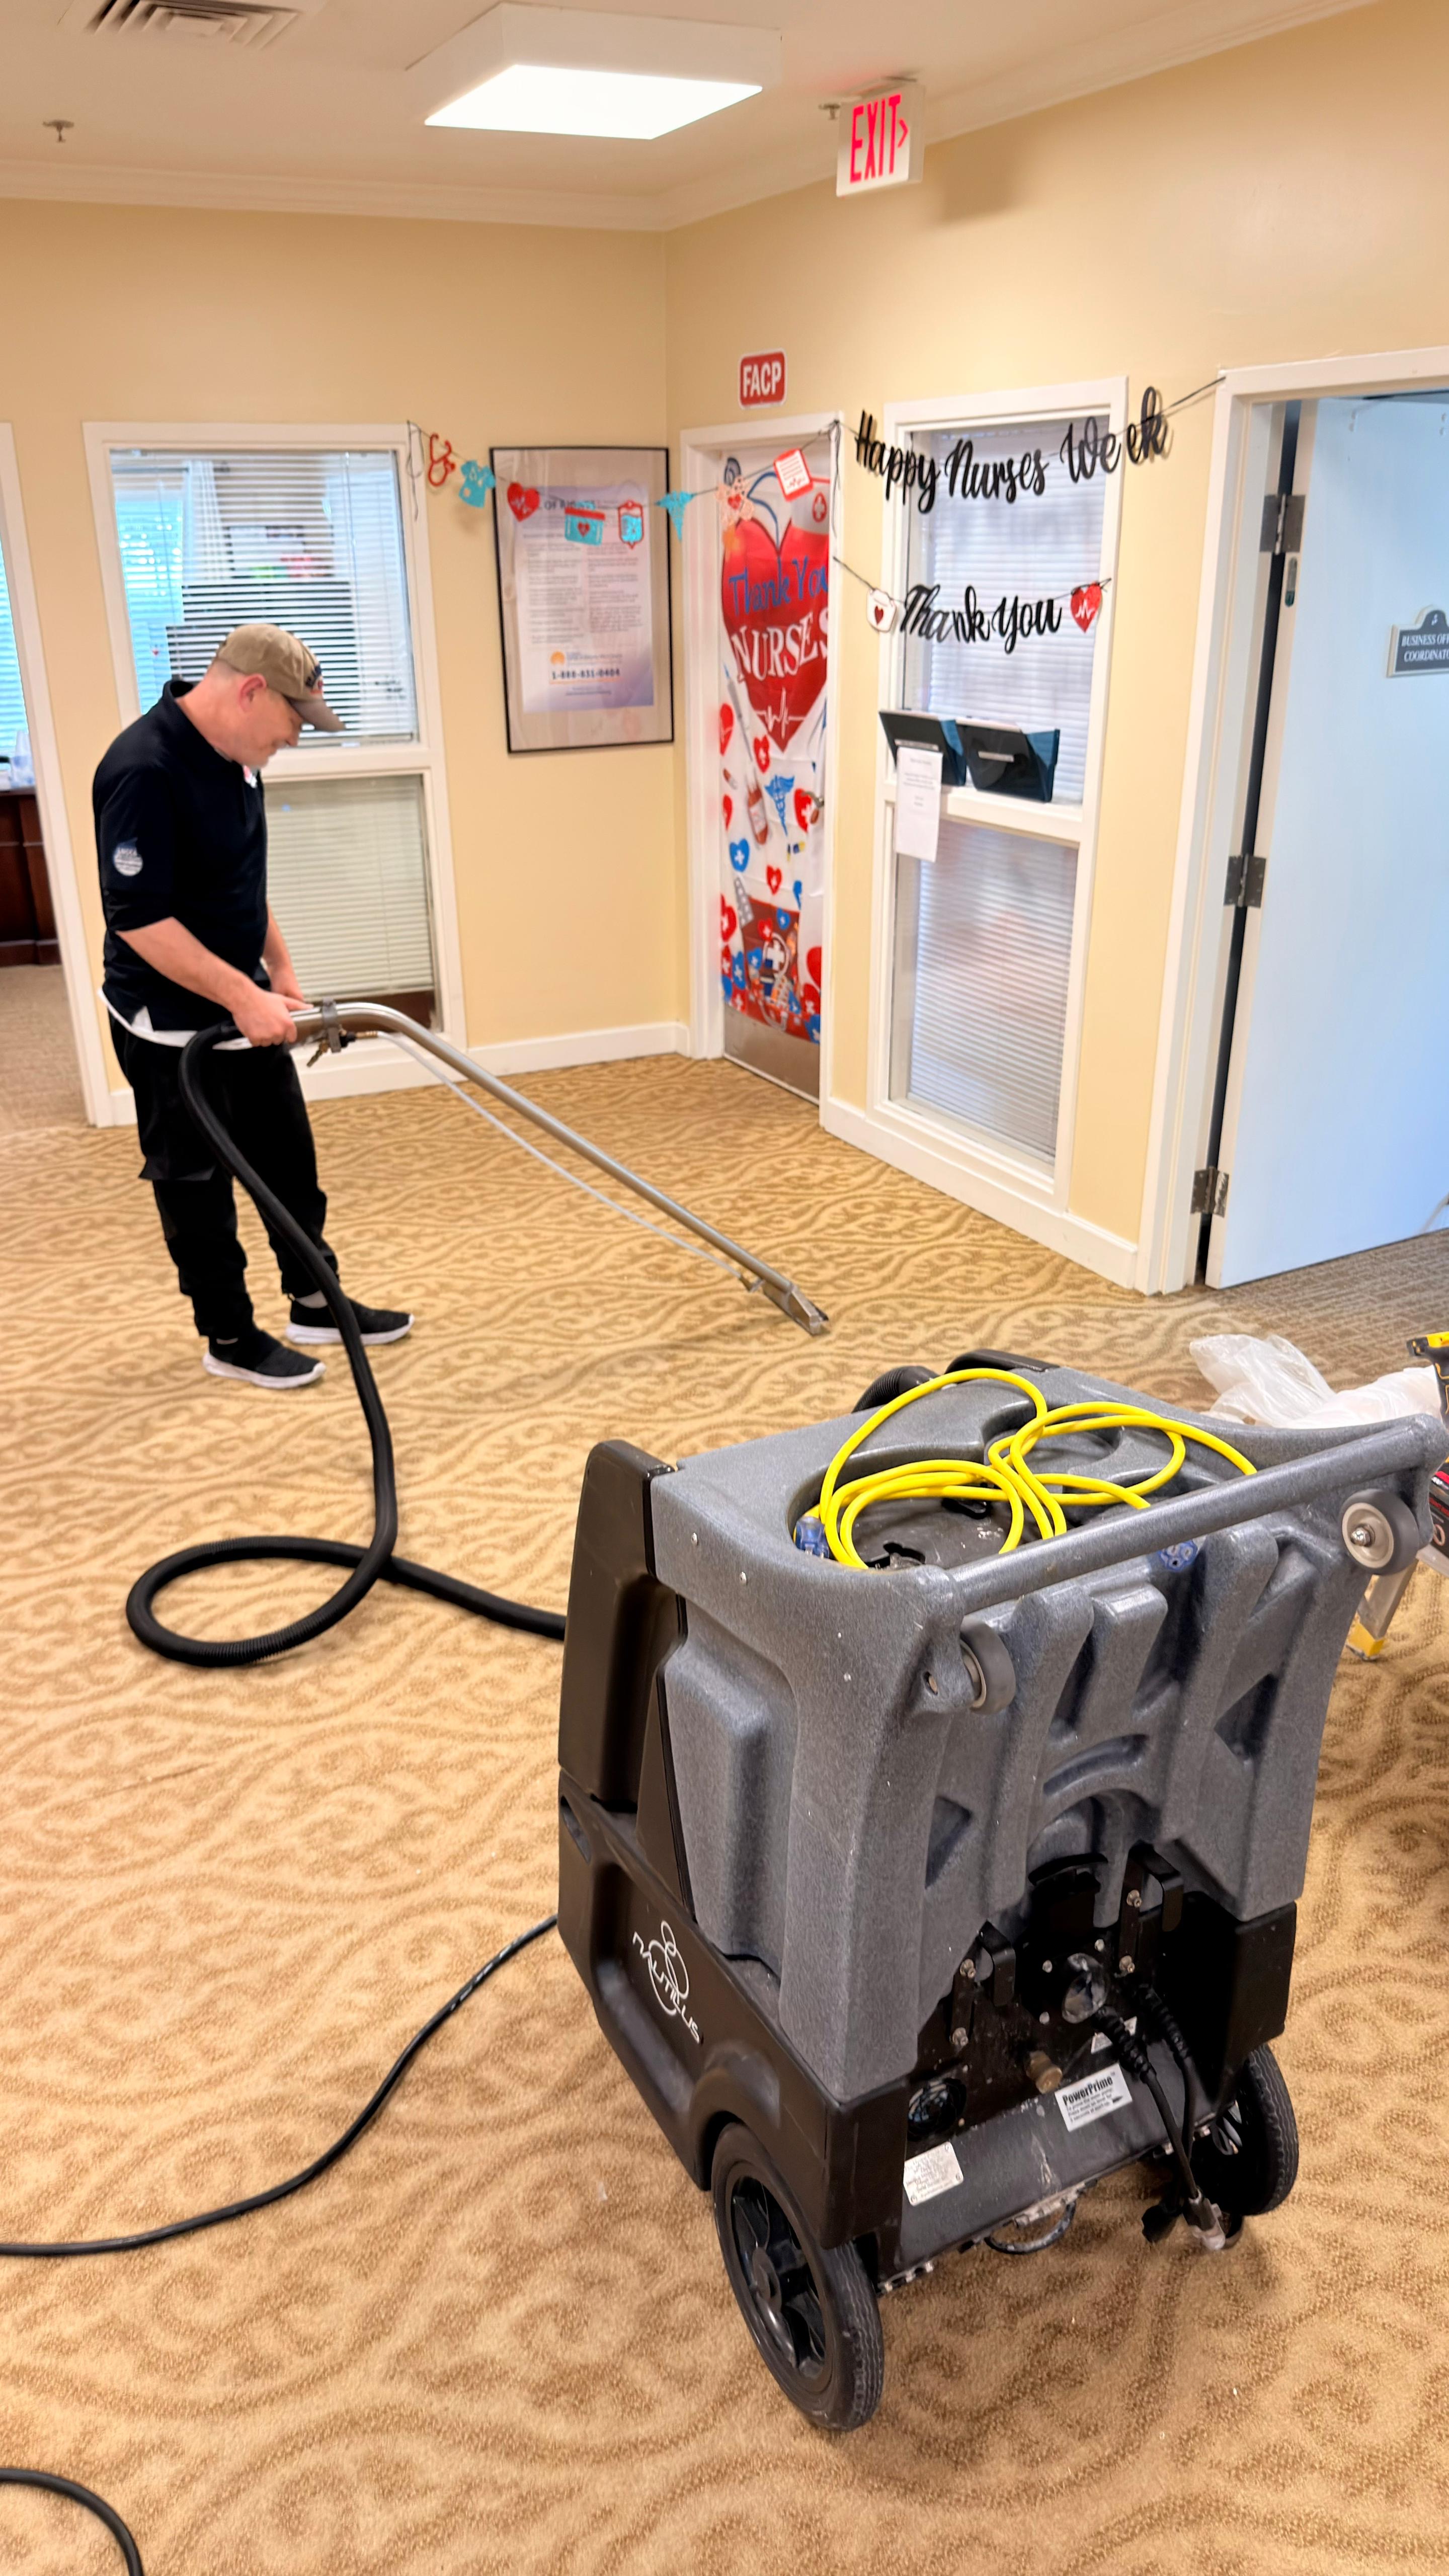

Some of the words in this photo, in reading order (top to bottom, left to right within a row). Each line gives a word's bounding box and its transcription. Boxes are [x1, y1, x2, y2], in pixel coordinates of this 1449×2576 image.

[850, 93, 902, 184] EXIT
[743, 360, 782, 398] FACP
[854, 409, 940, 514] Happy
[944, 439, 1050, 504] Nurses
[729, 556, 791, 616] Thank
[899, 584, 990, 643] Thank
[1401, 633, 1436, 647] BUSINESS
[1062, 2076, 1113, 2106] PowerPrime
